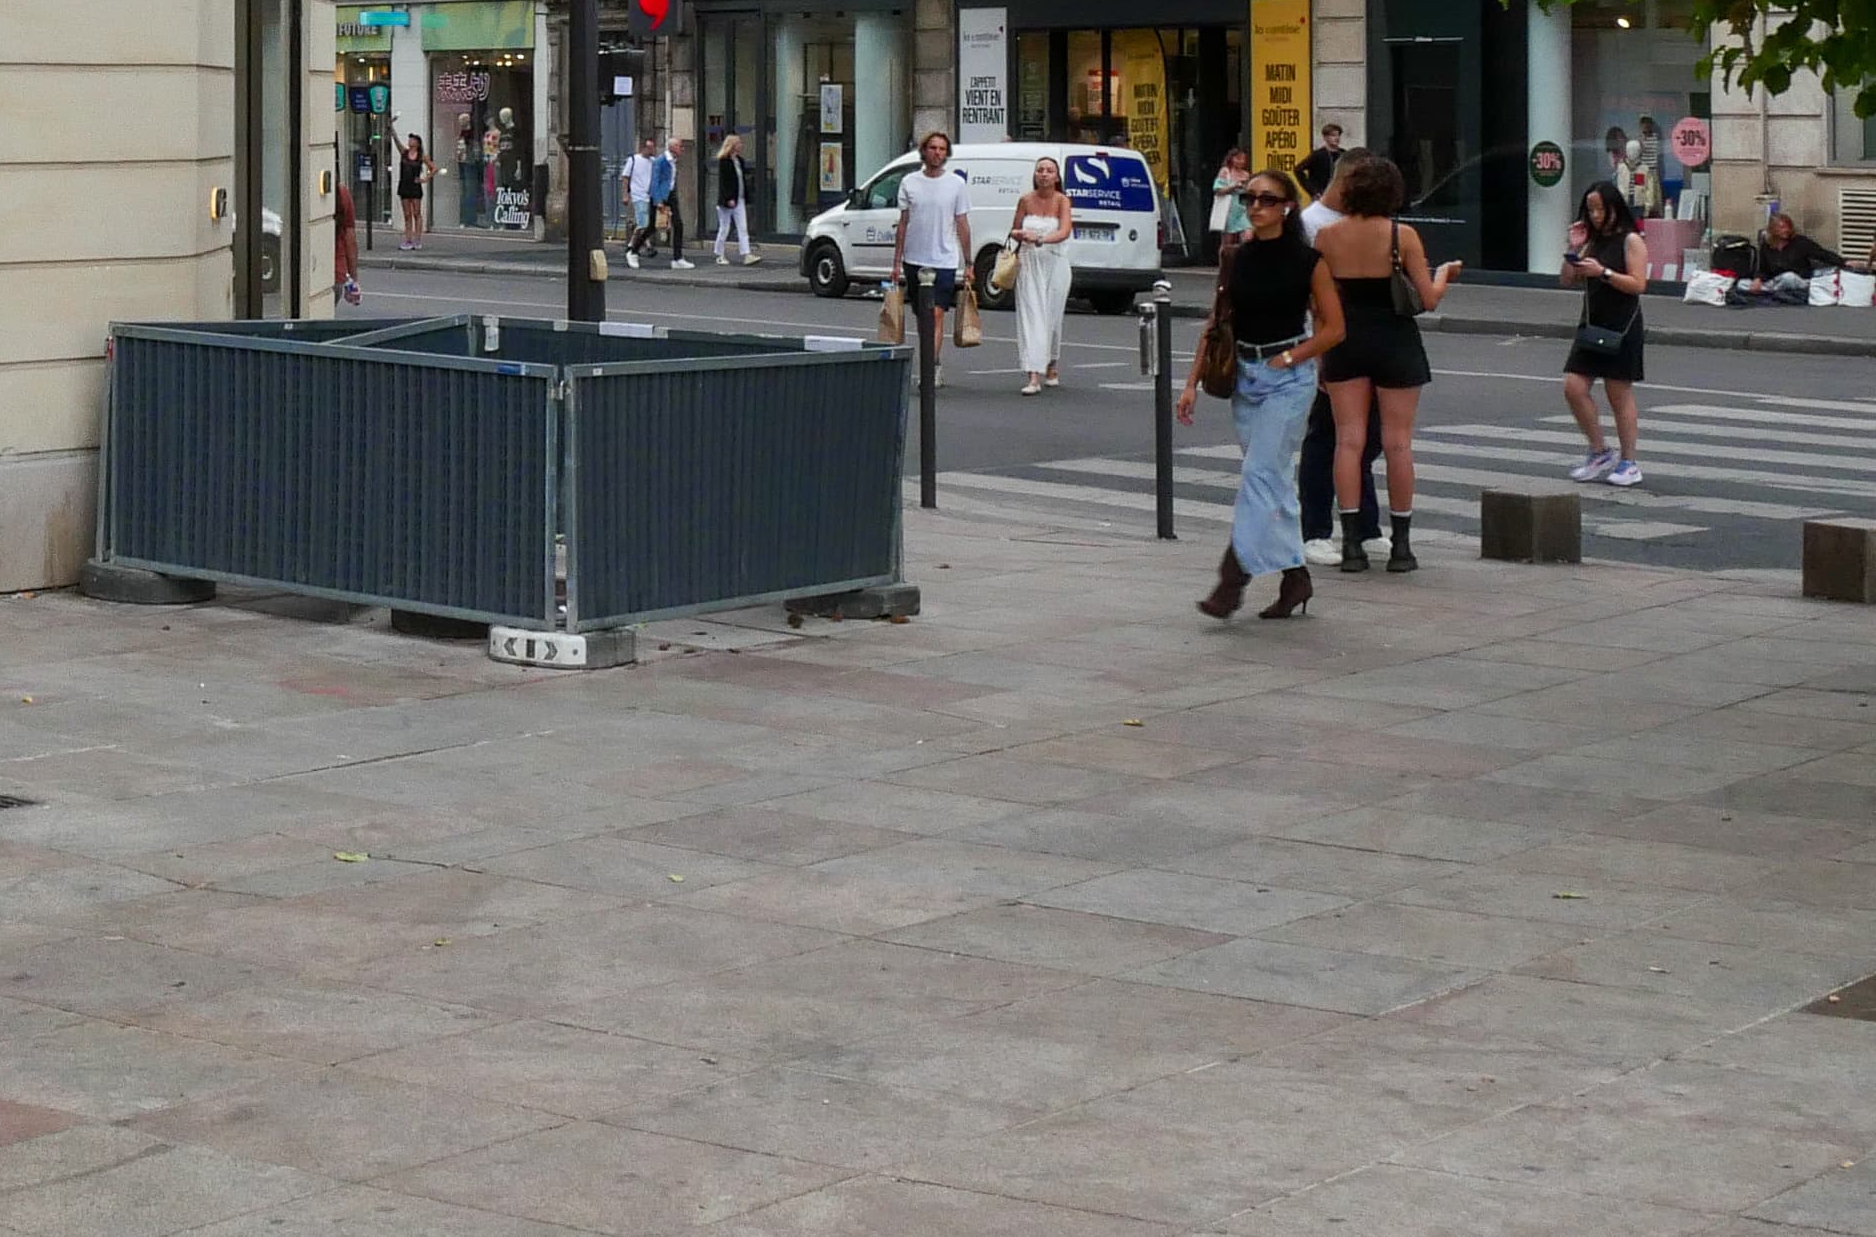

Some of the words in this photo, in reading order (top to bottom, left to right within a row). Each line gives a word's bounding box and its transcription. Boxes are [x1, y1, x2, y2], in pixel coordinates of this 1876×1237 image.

[1265, 63, 1296, 82] MATIN
[965, 89, 989, 107] VIENT
[990, 89, 1002, 107] EN
[1269, 87, 1292, 104] MIDI
[962, 107, 1005, 125] RENTRANT
[1262, 106, 1300, 127] GOÛTER
[1265, 127, 1297, 149] APÉRO
[1675, 129, 1707, 147] -30%
[1532, 151, 1562, 170] -30%
[495, 186, 530, 206] Tokyo's
[1066, 188, 1122, 200] STARSERVICE
[494, 204, 531, 230] Calling
